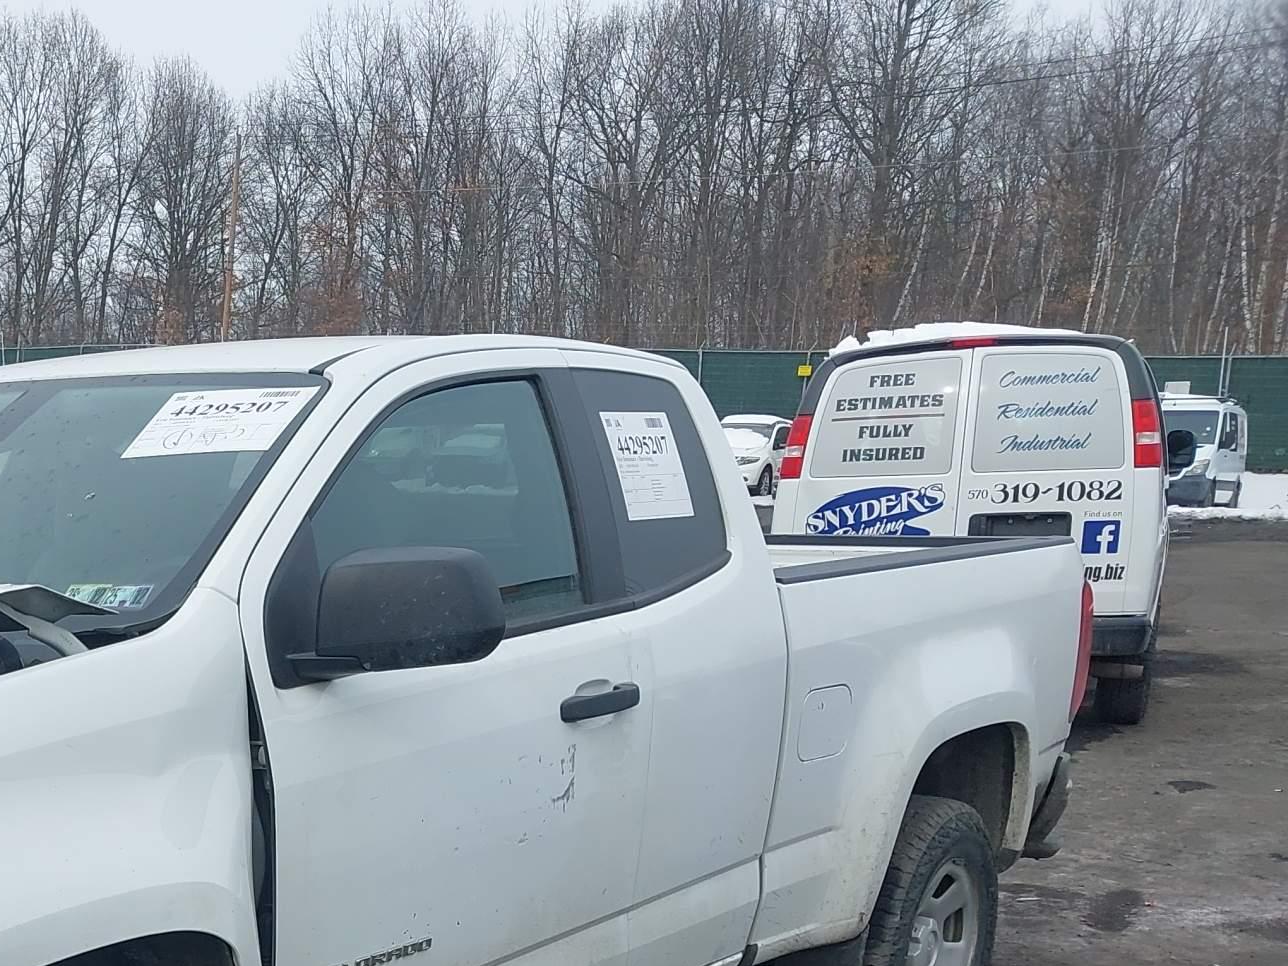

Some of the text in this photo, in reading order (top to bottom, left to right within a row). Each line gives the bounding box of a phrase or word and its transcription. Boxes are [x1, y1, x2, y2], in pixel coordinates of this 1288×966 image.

[869, 373, 916, 388] FREE
[999, 366, 1101, 388] Commercial
[170, 401, 289, 417] 44295207
[835, 394, 944, 412] ESTIMATES
[997, 398, 1098, 420] Residential
[858, 424, 914, 439] FULLY
[617, 435, 669, 455] 44295207
[995, 432, 1092, 454] Industrial
[841, 446, 925, 463] INSURED
[968, 489, 988, 500] 570
[807, 483, 946, 534] SNYDER'S
[1084, 510, 1100, 518] Find
[833, 519, 906, 536] inting
[1083, 563, 1125, 582] ng.biz
